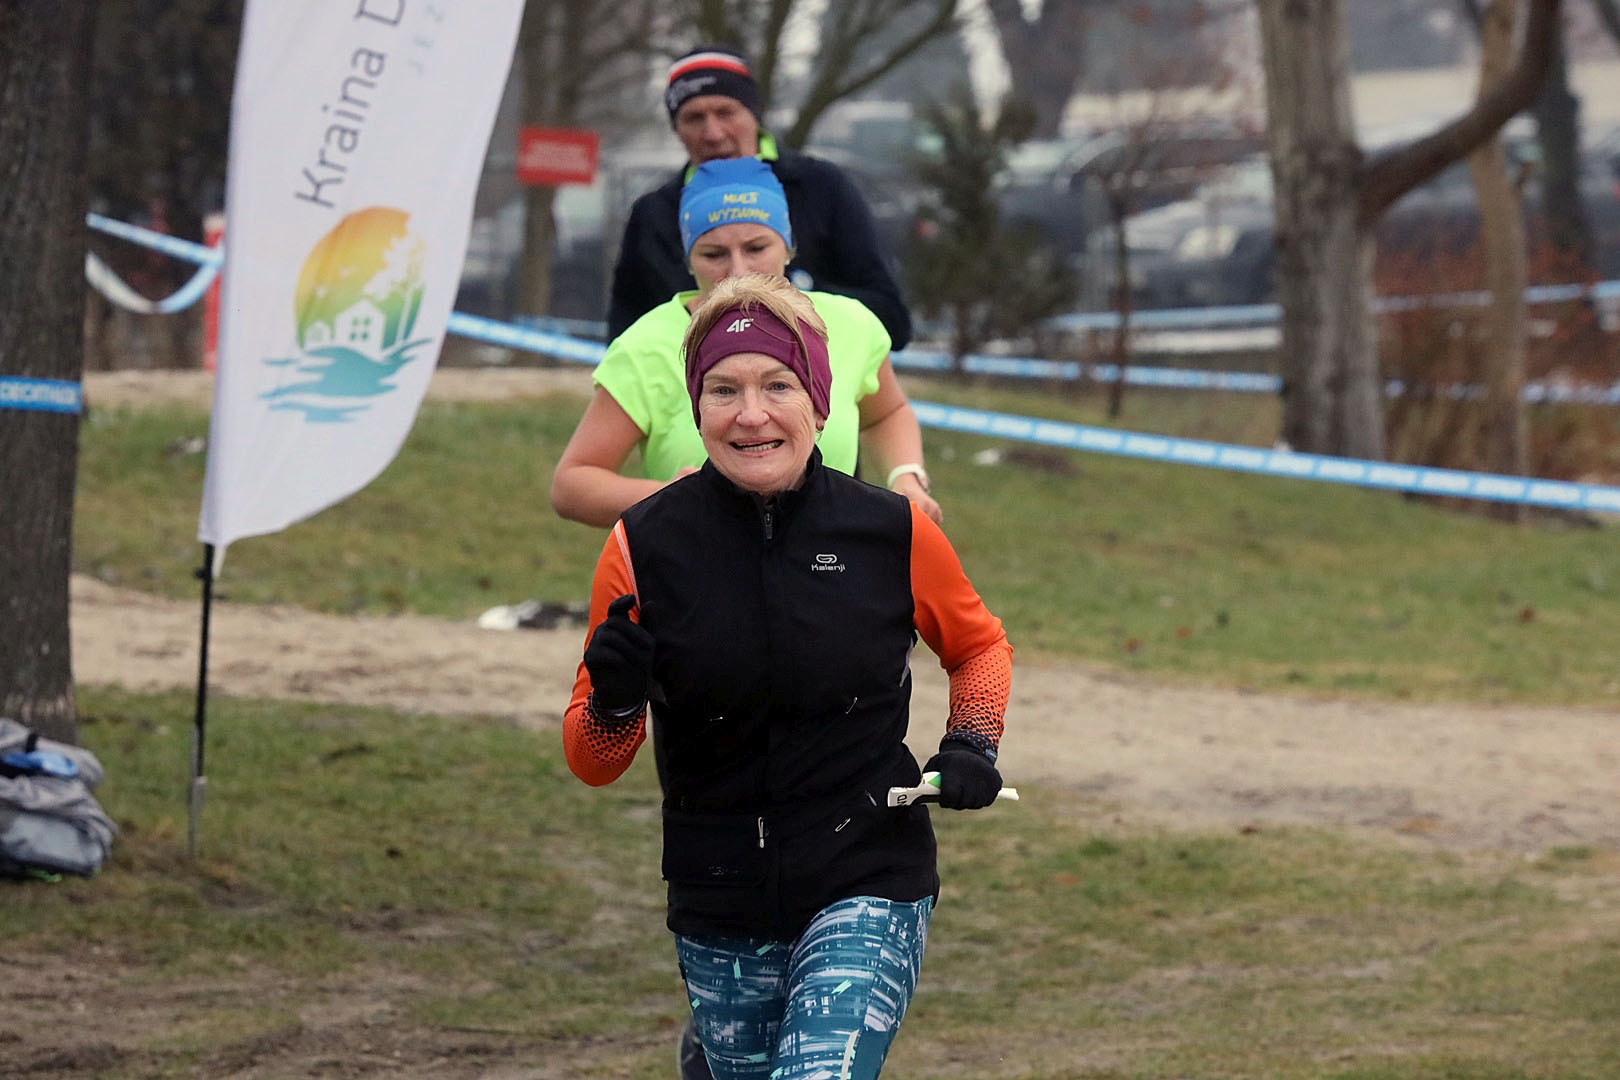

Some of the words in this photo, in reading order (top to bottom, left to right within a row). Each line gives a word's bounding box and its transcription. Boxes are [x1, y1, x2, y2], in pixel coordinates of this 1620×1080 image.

[294, 47, 387, 208] Kraina
[726, 318, 754, 333] 4F
[811, 564, 846, 572] Kalenji
